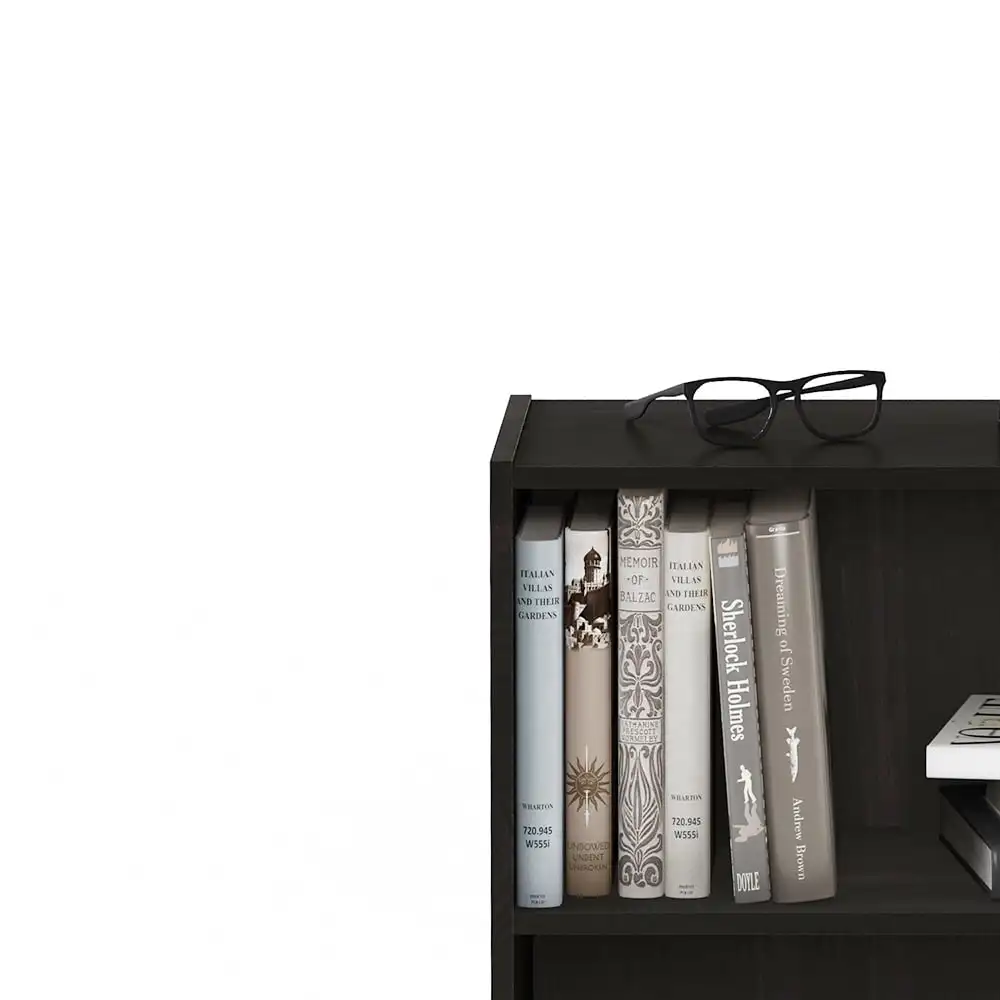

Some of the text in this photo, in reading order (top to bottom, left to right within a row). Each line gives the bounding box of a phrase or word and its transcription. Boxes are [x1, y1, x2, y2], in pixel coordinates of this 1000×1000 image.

[620, 556, 659, 568] MEMOIR
[669, 562, 704, 570] ITALIAN
[520, 570, 555, 578] ITALIAN
[672, 576, 702, 584] VILLAS
[522, 584, 552, 592] VILLAS
[620, 592, 656, 604] BALZAC
[684, 590, 709, 598] THEIR
[534, 597, 560, 606] THEIR
[667, 604, 707, 612] GARDENS
[518, 612, 558, 620] GARDENS
[774, 567, 796, 712] Dreaming of Sweden
[721, 598, 751, 742] Sherlock Holmes
[522, 802, 554, 810] WHARTON
[672, 817, 702, 827] 720.945
[523, 826, 553, 836] 720.945
[674, 830, 699, 840] W555i
[526, 839, 551, 849] W555i
[792, 798, 807, 881] Andrew Brown
[736, 872, 760, 892] DOYLE
